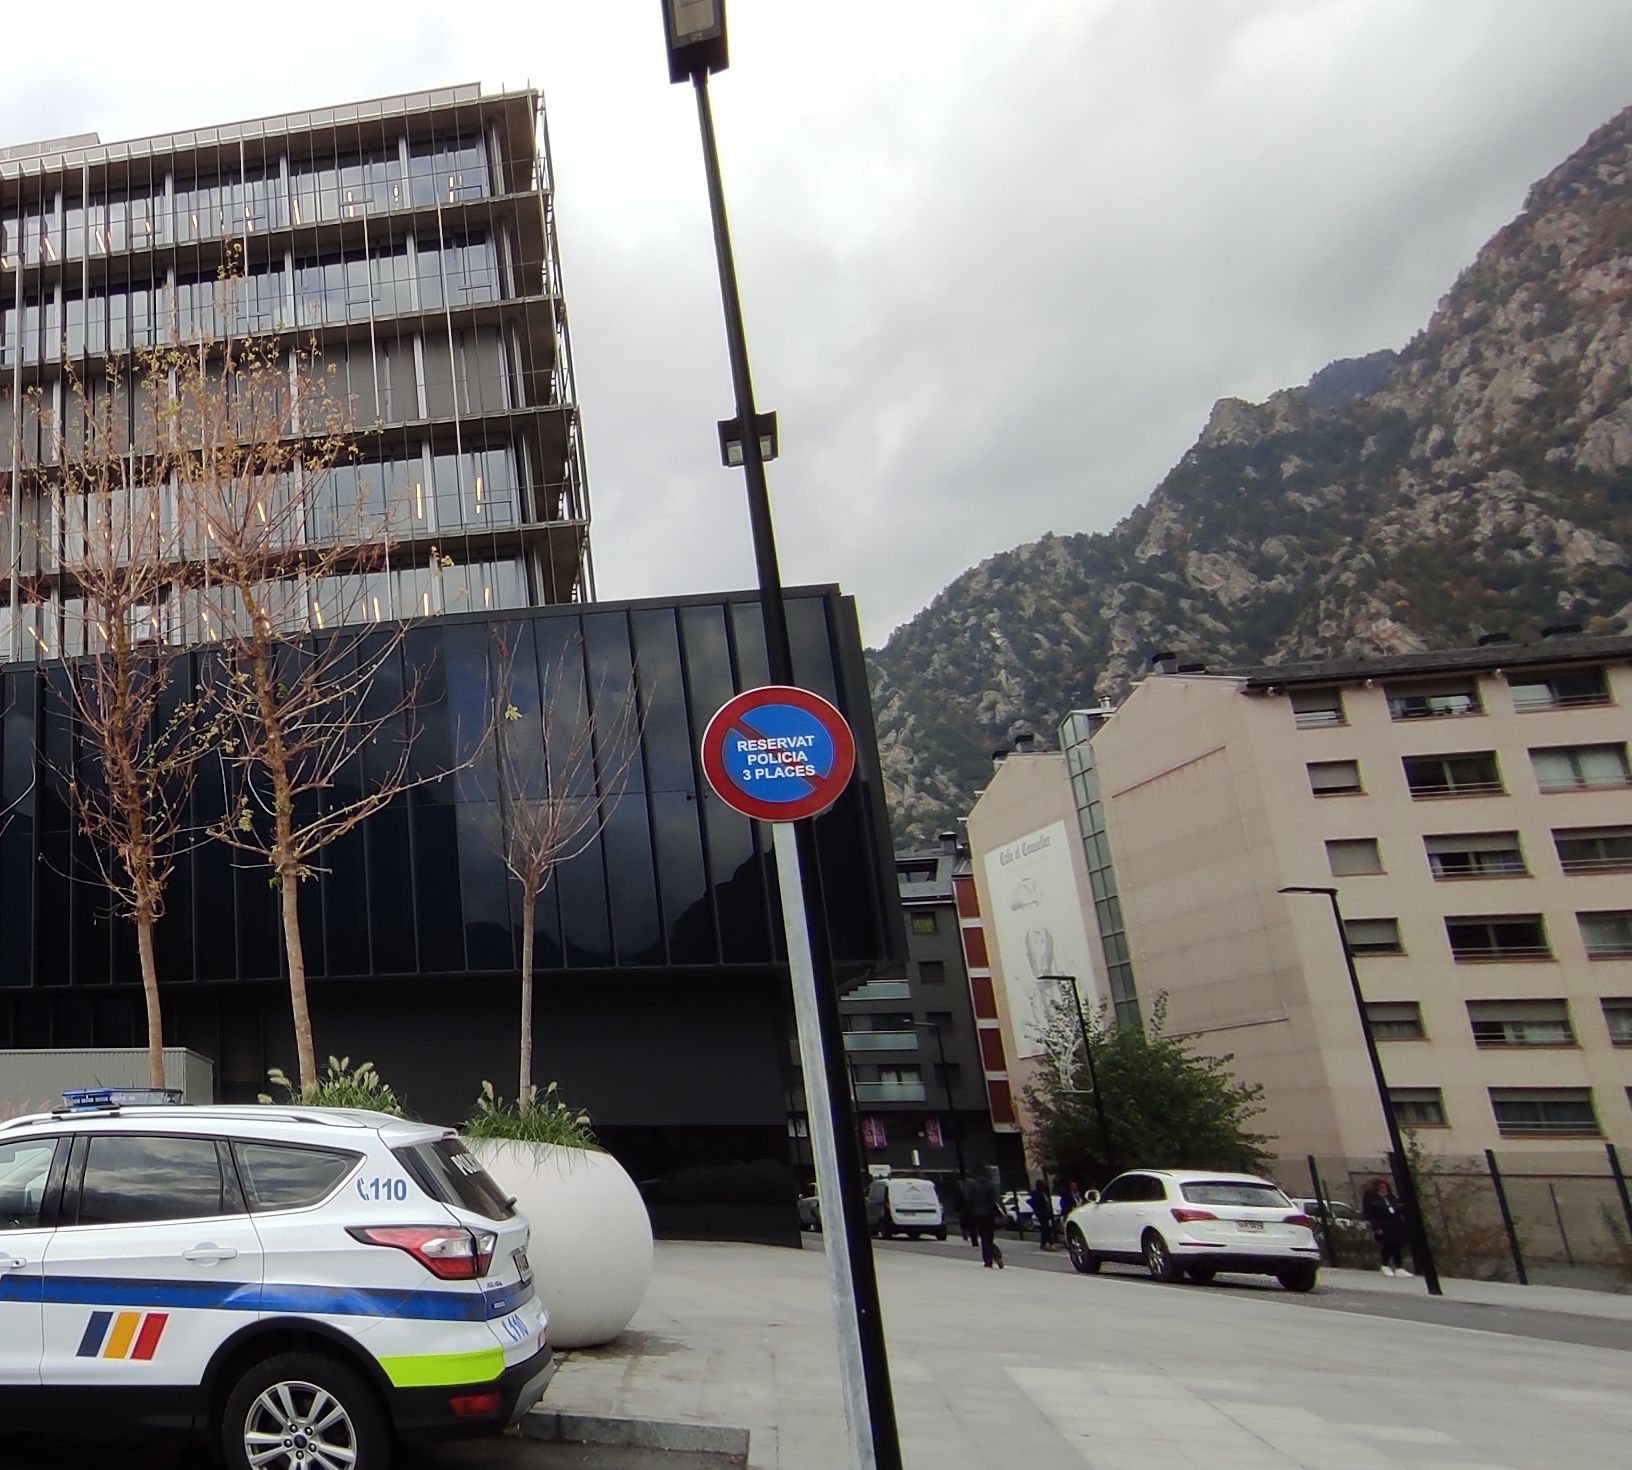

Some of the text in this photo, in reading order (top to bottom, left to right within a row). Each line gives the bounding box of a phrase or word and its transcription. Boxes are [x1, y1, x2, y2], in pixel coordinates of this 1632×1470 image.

[737, 735, 815, 752] RESERVAT
[747, 750, 808, 766] POLICIA
[742, 765, 816, 780] 3 PLACES
[369, 1177, 407, 1201] 110
